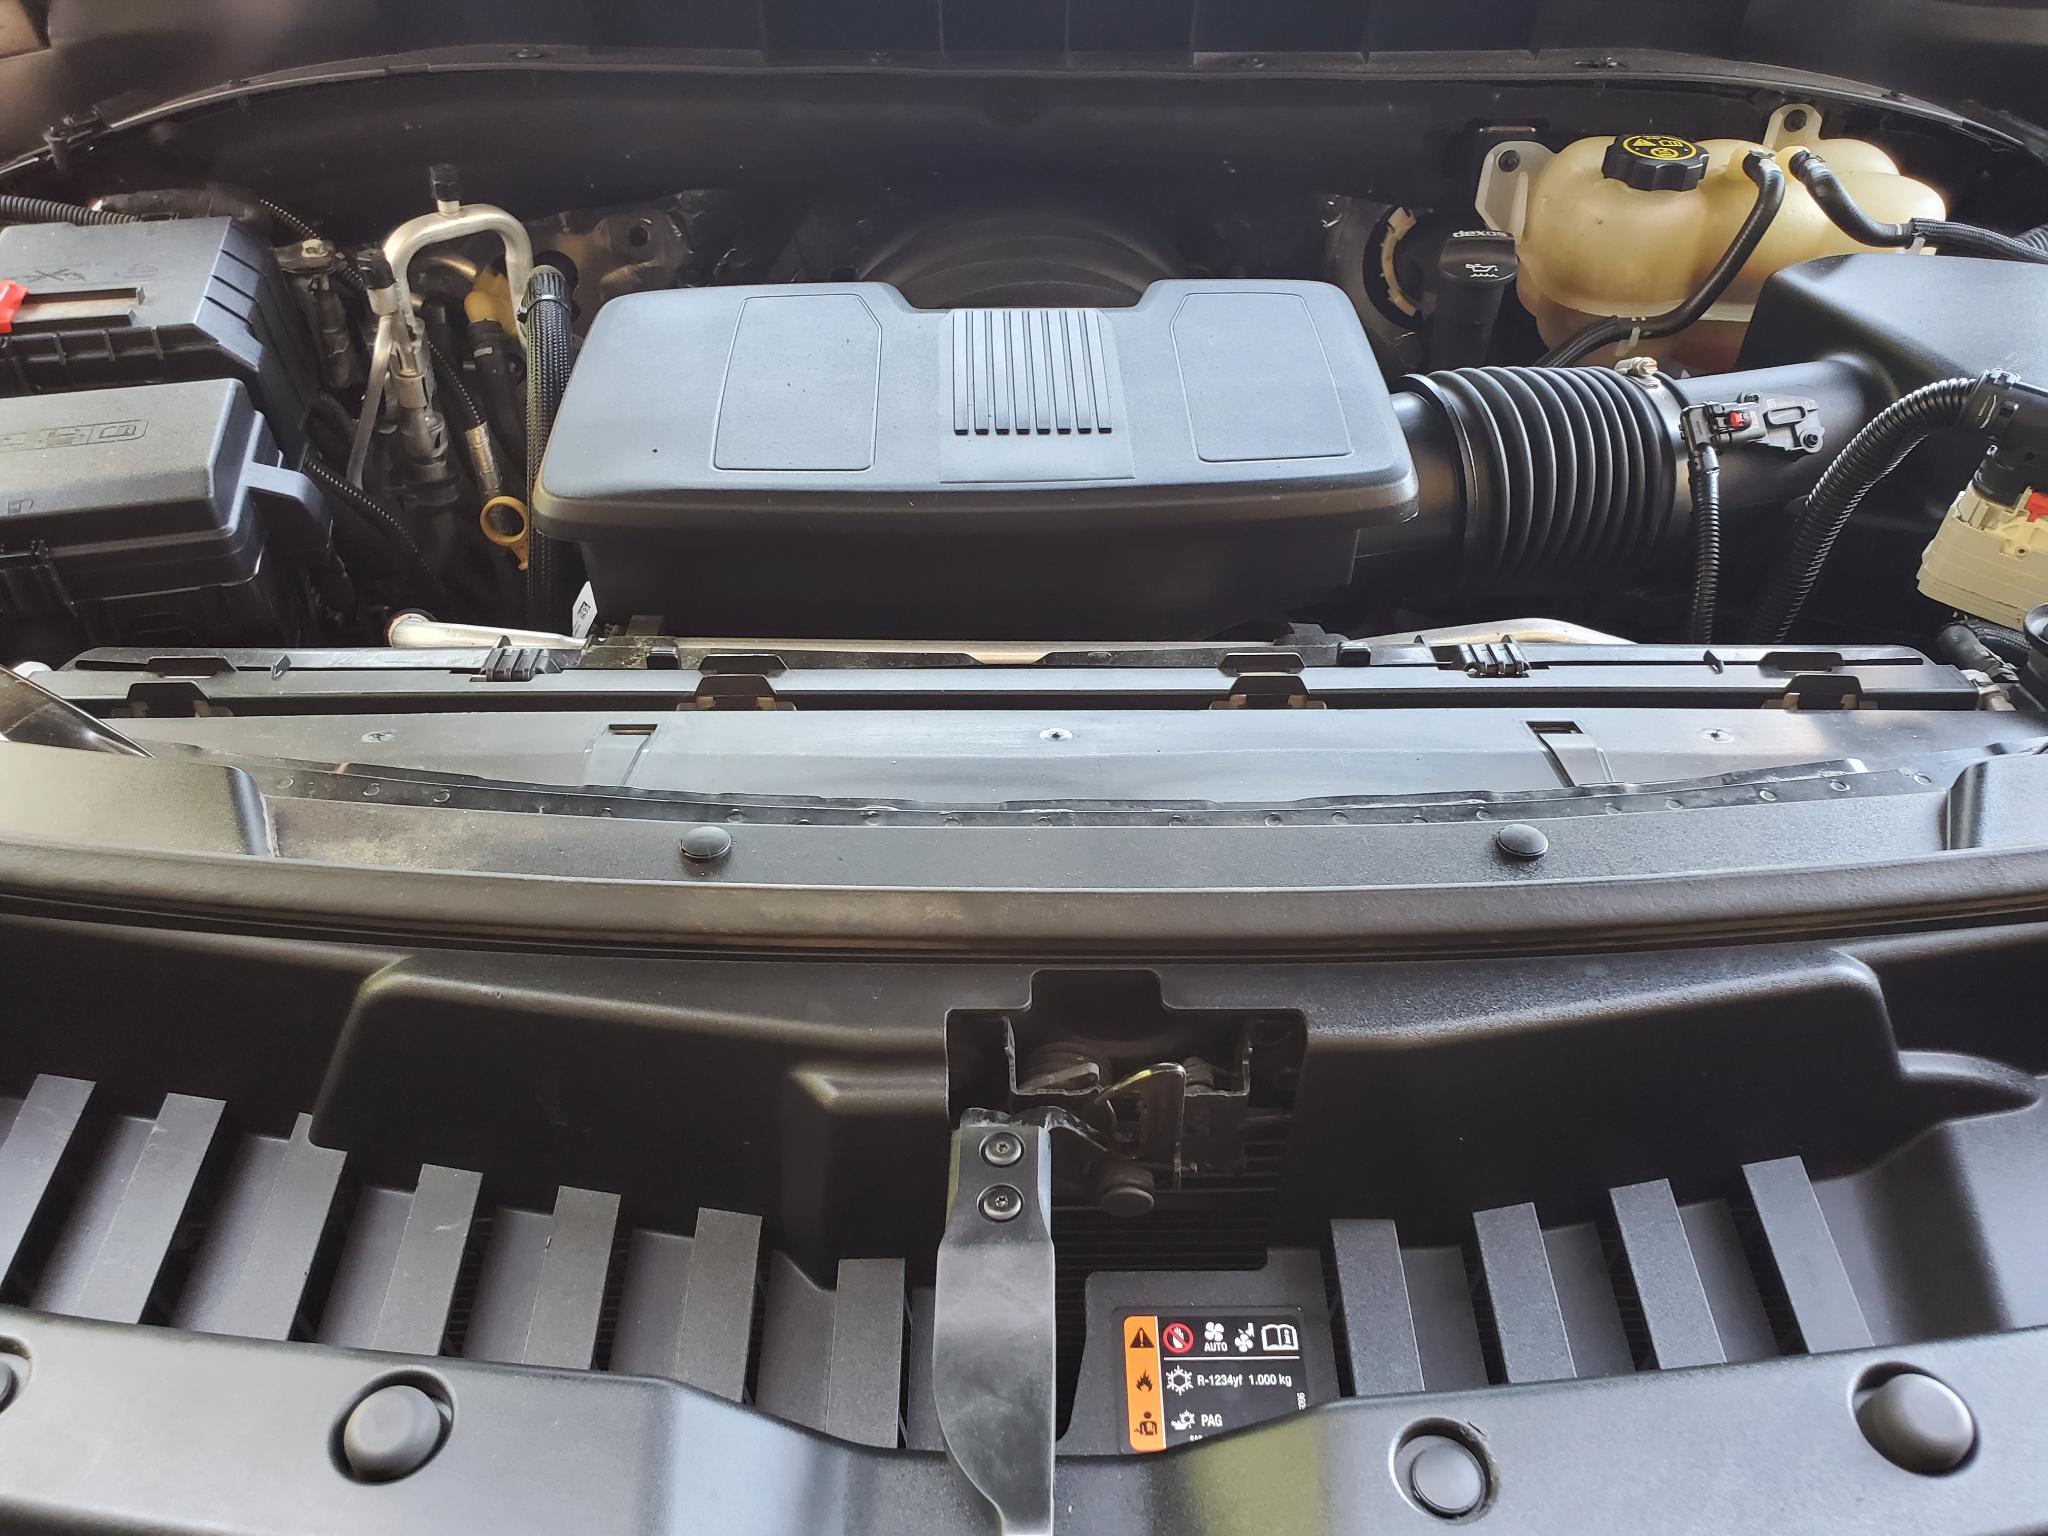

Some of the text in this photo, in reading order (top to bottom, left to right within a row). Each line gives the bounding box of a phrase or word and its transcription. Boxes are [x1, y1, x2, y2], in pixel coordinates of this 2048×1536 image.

[1452, 230, 1509, 238] dexos
[1204, 1342, 1228, 1352] AUTO
[1197, 1373, 1292, 1389] R-1234yf 1.000 kg
[1201, 1413, 1223, 1427] PAG
